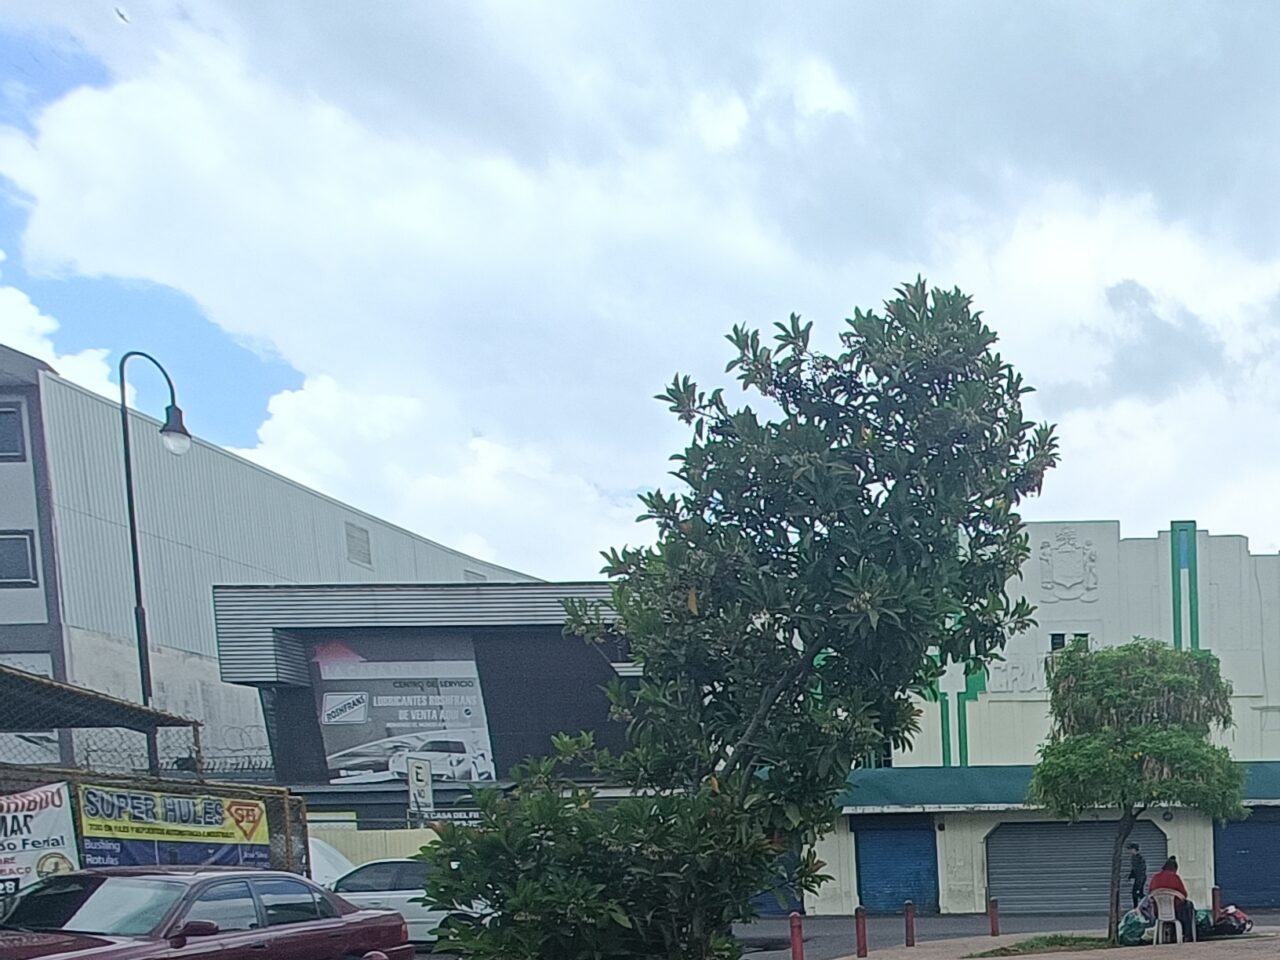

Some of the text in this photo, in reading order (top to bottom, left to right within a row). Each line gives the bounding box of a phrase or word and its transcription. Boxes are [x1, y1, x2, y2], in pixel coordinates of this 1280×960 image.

[393, 681, 424, 689] CENTRO
[373, 695, 428, 707] LUBRICANTES
[398, 709, 409, 720] DE
[411, 709, 438, 720] VENTA
[84, 788, 225, 827] SUPER HULES
[21, 835, 65, 851] Ferial
[84, 839, 121, 853] Bushing
